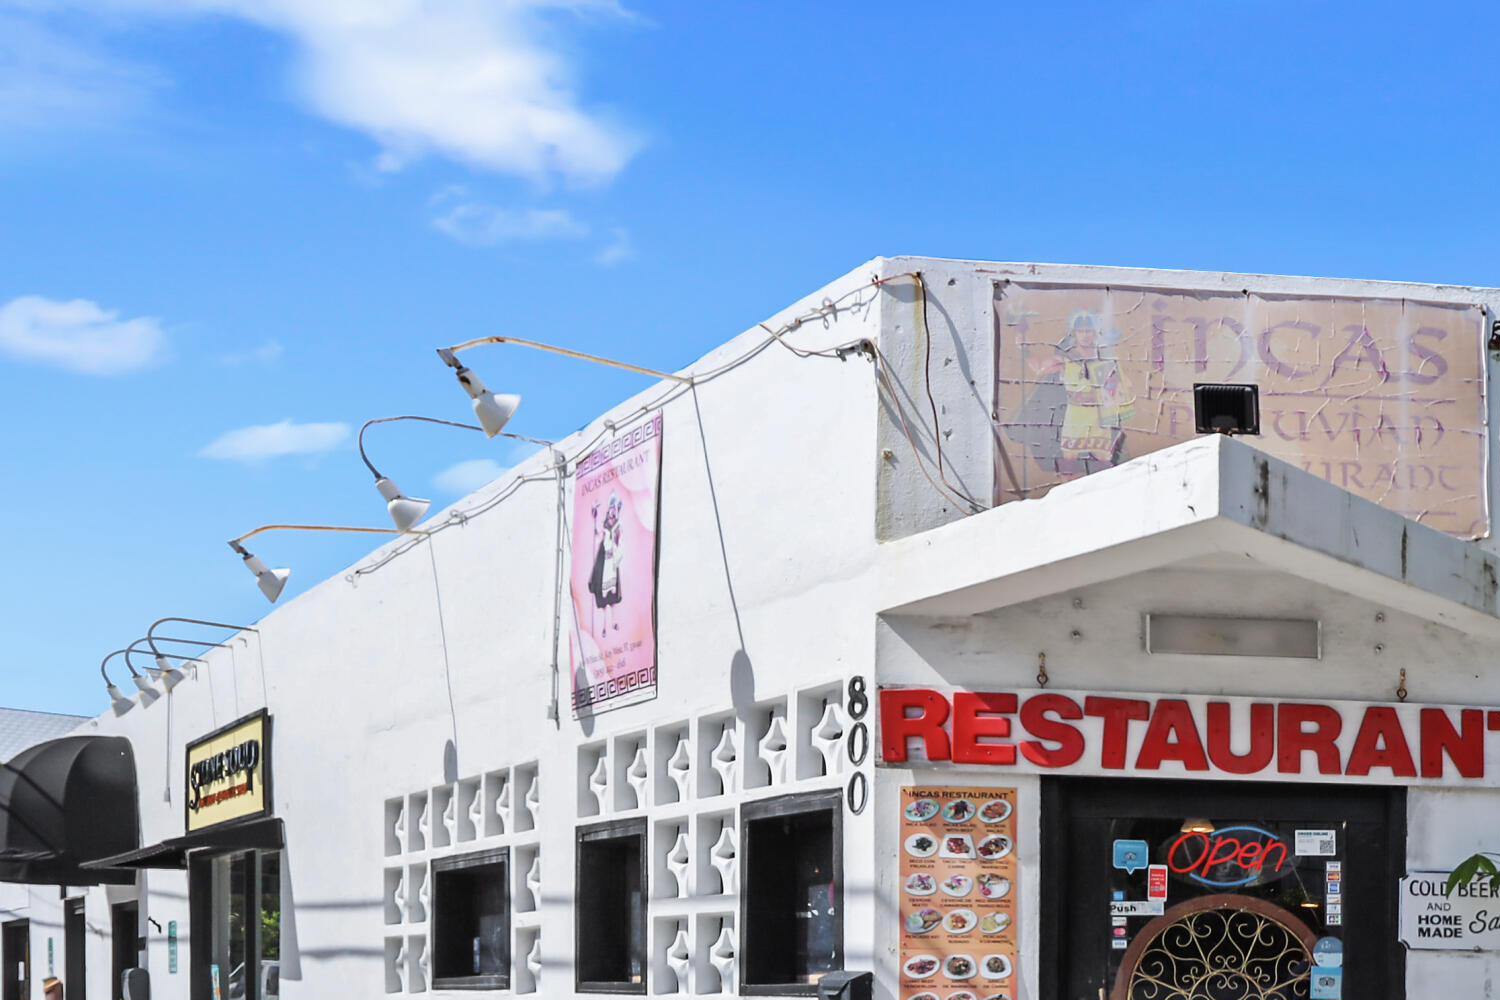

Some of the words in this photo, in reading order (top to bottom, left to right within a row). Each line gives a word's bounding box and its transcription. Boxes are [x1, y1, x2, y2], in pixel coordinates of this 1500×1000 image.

[1169, 404, 1445, 449] PUVIAN
[847, 675, 868, 815] 800
[942, 791, 1009, 800] RESTAURANT
[1168, 831, 1287, 878] Open
[1409, 880, 1448, 896] COLD
[1110, 904, 1137, 912] Push
[1427, 902, 1451, 912] AND
[1418, 915, 1462, 925] HOME
[1418, 927, 1462, 938] MADE
